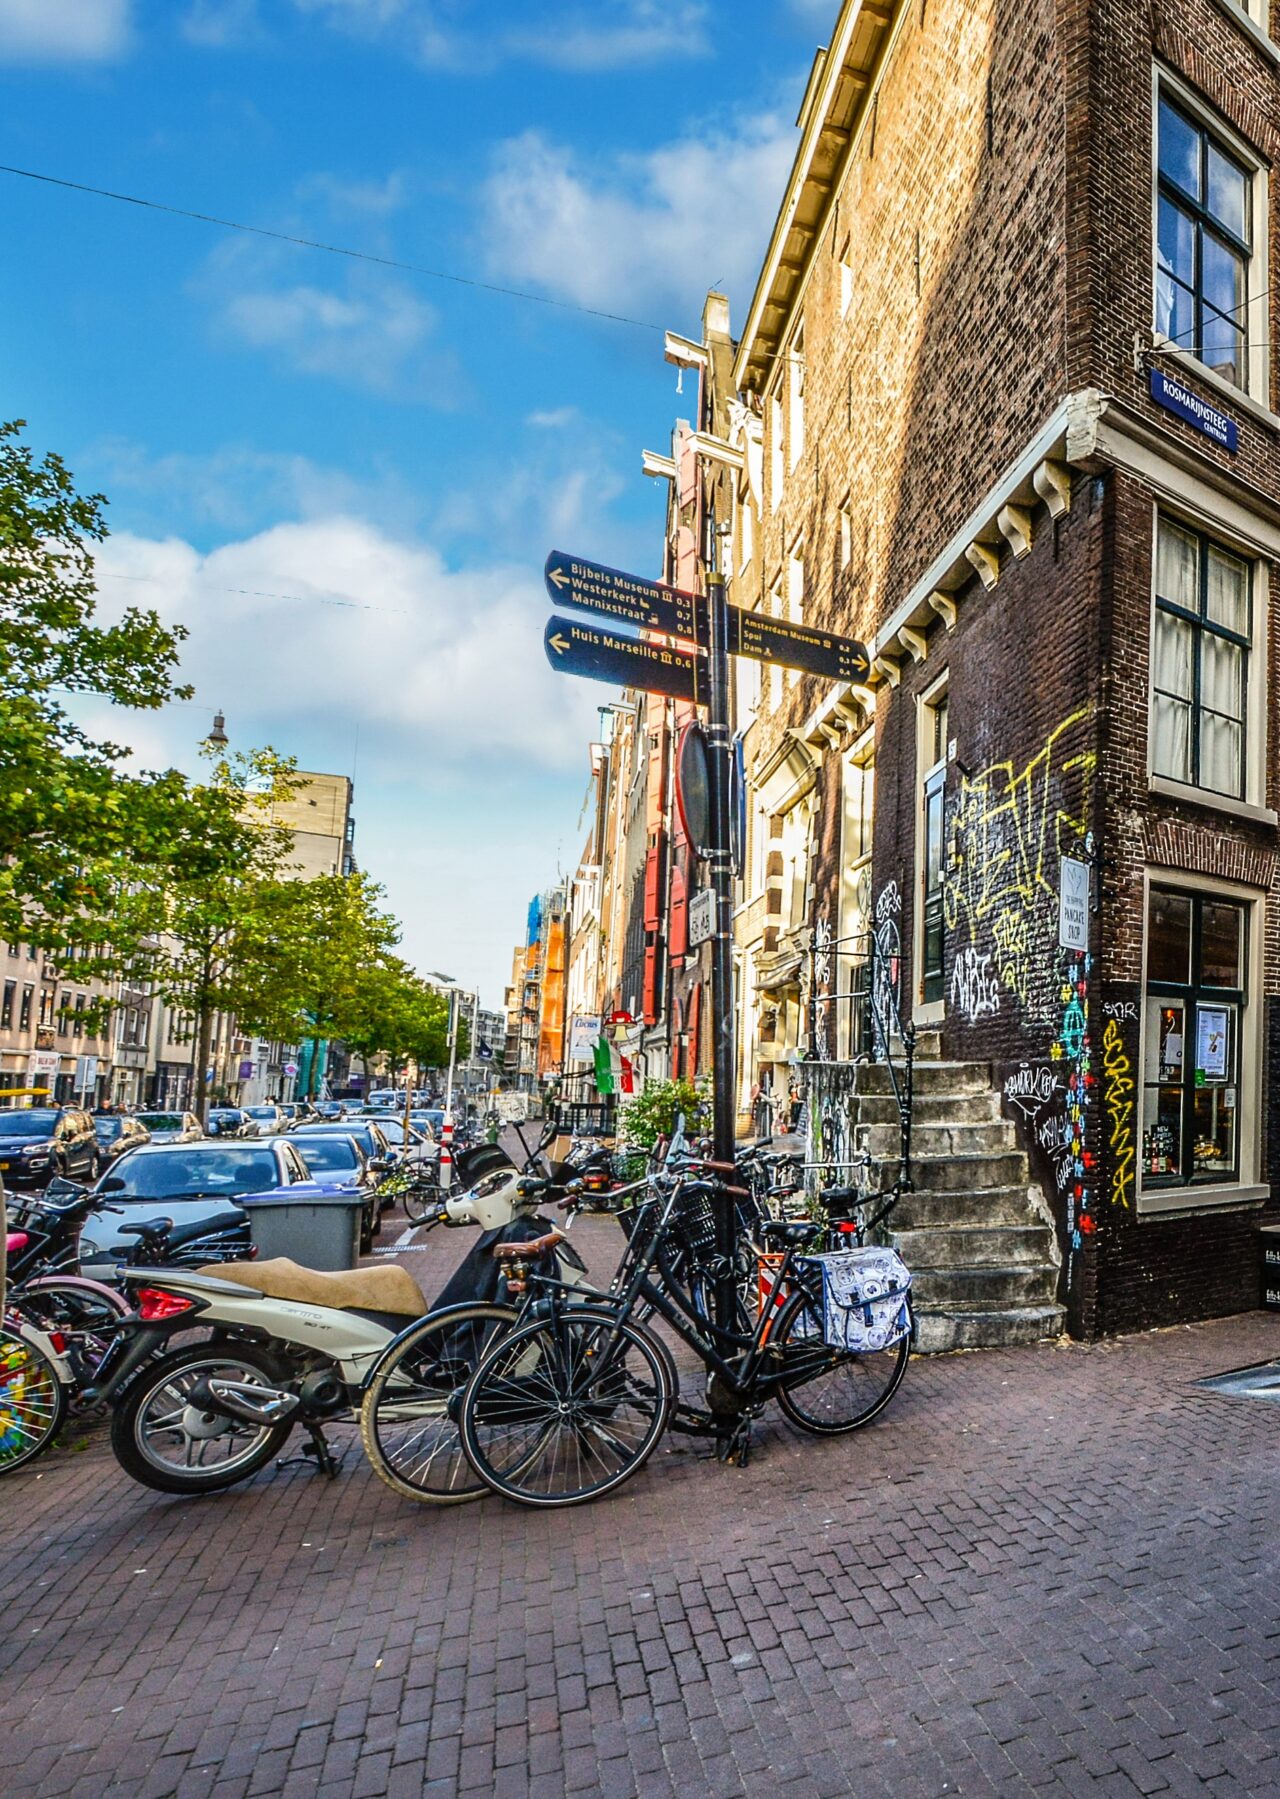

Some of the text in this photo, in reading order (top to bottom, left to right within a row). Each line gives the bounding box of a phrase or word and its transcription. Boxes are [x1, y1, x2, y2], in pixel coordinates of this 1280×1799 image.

[1163, 380, 1227, 432] ROSMARIJNSTEEG
[1204, 422, 1227, 443] CENTRUM
[571, 563, 611, 584] Bijbels
[613, 576, 659, 599] Museum
[571, 577, 637, 605] Westerkerk
[572, 592, 645, 621] Marnixstraat
[571, 627, 599, 644] Huis
[603, 636, 658, 660] Marseille
[743, 630, 762, 641] Spui
[745, 618, 789, 636] Amsterdam
[790, 630, 820, 646] Museum
[743, 642, 762, 654] Dam
